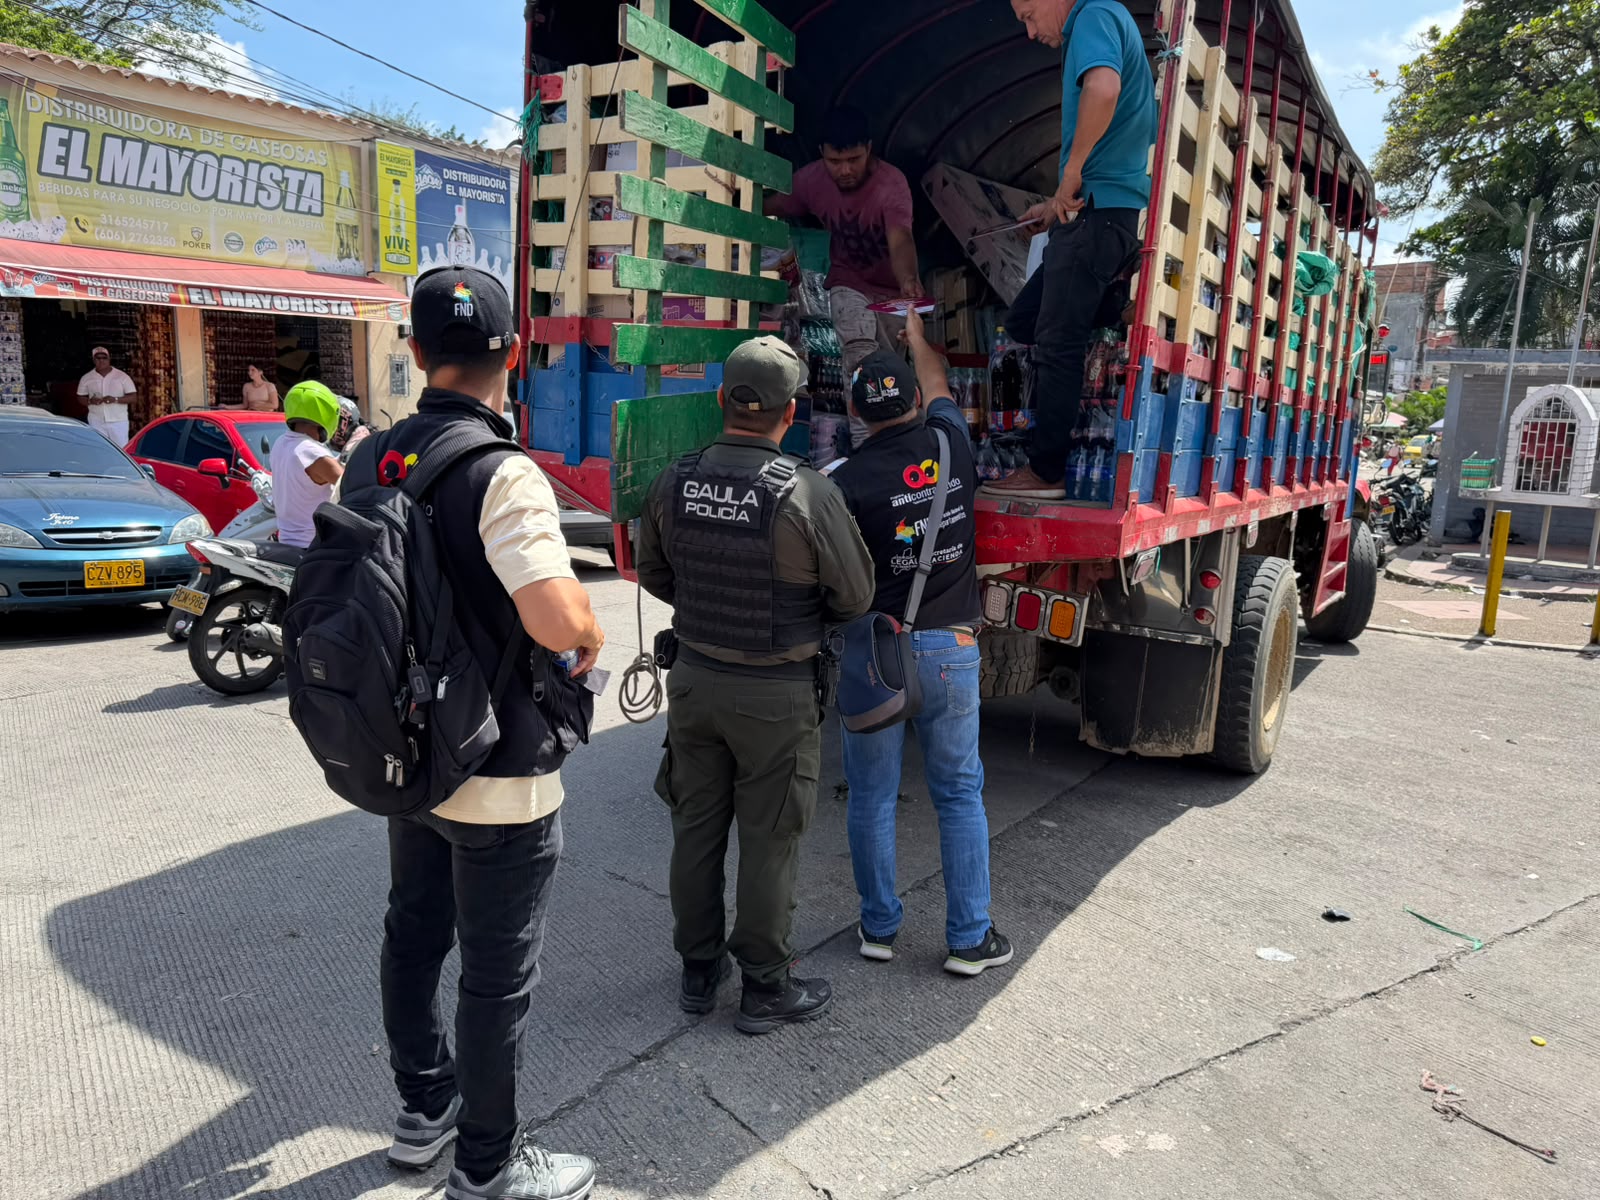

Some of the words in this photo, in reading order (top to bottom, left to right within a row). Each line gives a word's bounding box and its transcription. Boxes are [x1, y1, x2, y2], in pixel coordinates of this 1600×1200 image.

[26, 91, 193, 142] DISTRIBUIDORA
[200, 128, 225, 148] DE
[231, 134, 328, 167] GASEOSAS
[38, 122, 91, 181] EL
[98, 133, 323, 216] MAYORISTA
[443, 167, 507, 191] DISTRIBUIDORA
[39, 182, 90, 199] BEBIDAS
[94, 189, 125, 204] PARA
[129, 195, 143, 206] SU
[146, 197, 201, 213] NEGOCIO
[212, 206, 233, 218] POR
[236, 209, 274, 224] MAYOR
[445, 184, 457, 196] EL
[458, 186, 506, 205] MAYORISTA
[100, 213, 169, 232] 3165245717
[94, 228, 126, 244] (606)
[129, 231, 176, 247] 2762350
[182, 240, 212, 250] POKER
[384, 235, 410, 253] VIVE
[79, 276, 176, 293] DISTRIBUIDORA
[88, 286, 104, 298] DE
[106, 288, 170, 303] GASEOSAS
[187, 287, 218, 306] EL
[220, 290, 357, 317] MAYORISTA
[454, 302, 474, 317] FND
[683, 481, 759, 507] GAULA
[892, 478, 961, 507] anticontrando
[685, 501, 750, 523] POLICÍA
[914, 516, 930, 537] FN
[931, 549, 963, 563] ACIENDA
